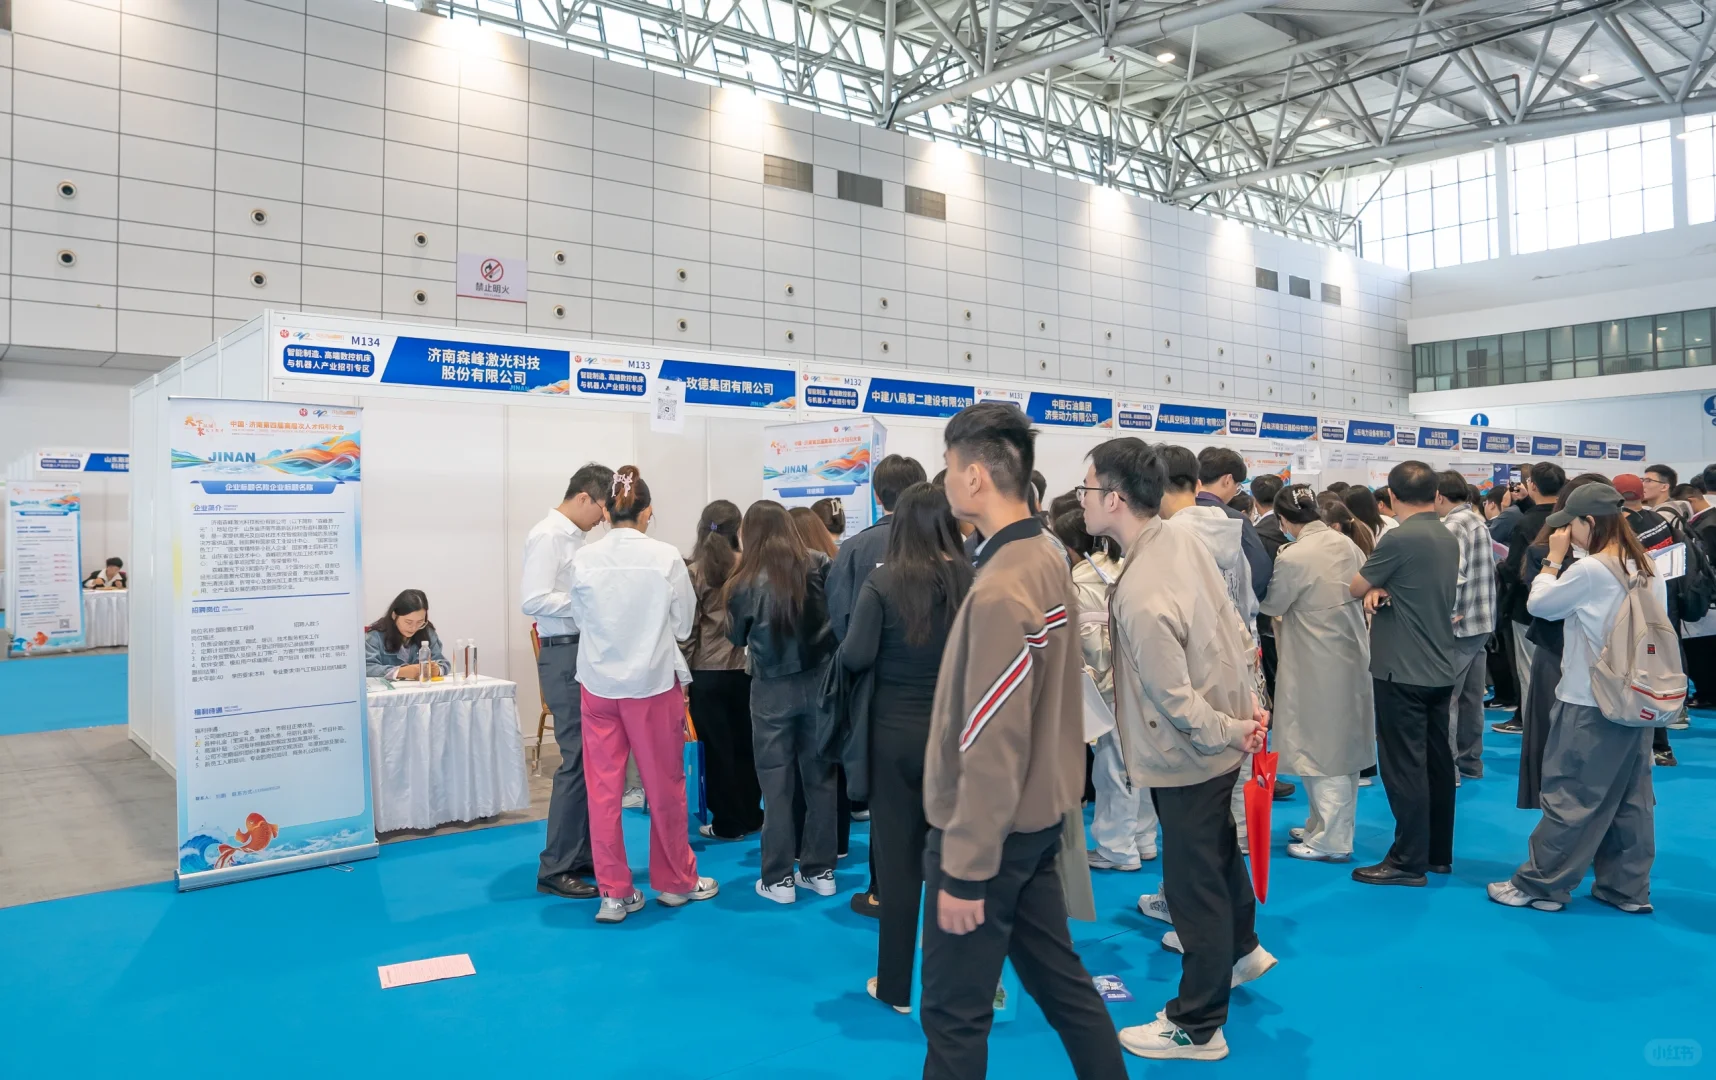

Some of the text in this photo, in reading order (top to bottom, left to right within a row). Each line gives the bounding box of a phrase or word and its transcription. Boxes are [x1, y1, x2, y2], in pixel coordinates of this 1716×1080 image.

[475, 282, 510, 294] 禁止明火
[351, 336, 380, 347] M134
[286, 348, 371, 362] 智能制造、高端数控机床
[427, 347, 541, 371] 济南森峰激光科技
[286, 359, 370, 373] 与机器人产业招引专区
[628, 360, 651, 370] M133
[441, 365, 526, 386] 股份有限公司
[580, 371, 645, 383] 智能制造、高端数控机床
[580, 381, 644, 393] 与机器人产业招引专区
[686, 376, 774, 396] 玫德集团有限公司
[844, 378, 862, 386] M132
[871, 390, 974, 408] 中建八局第二建设有限公司
[1051, 399, 1092, 412] 中国石油集团
[208, 451, 256, 463] JINAN
[782, 464, 808, 474] JINAN
[194, 504, 222, 512] 企业简介
[191, 606, 221, 614] 招聘岗位
[194, 706, 223, 716] 福利待遇
